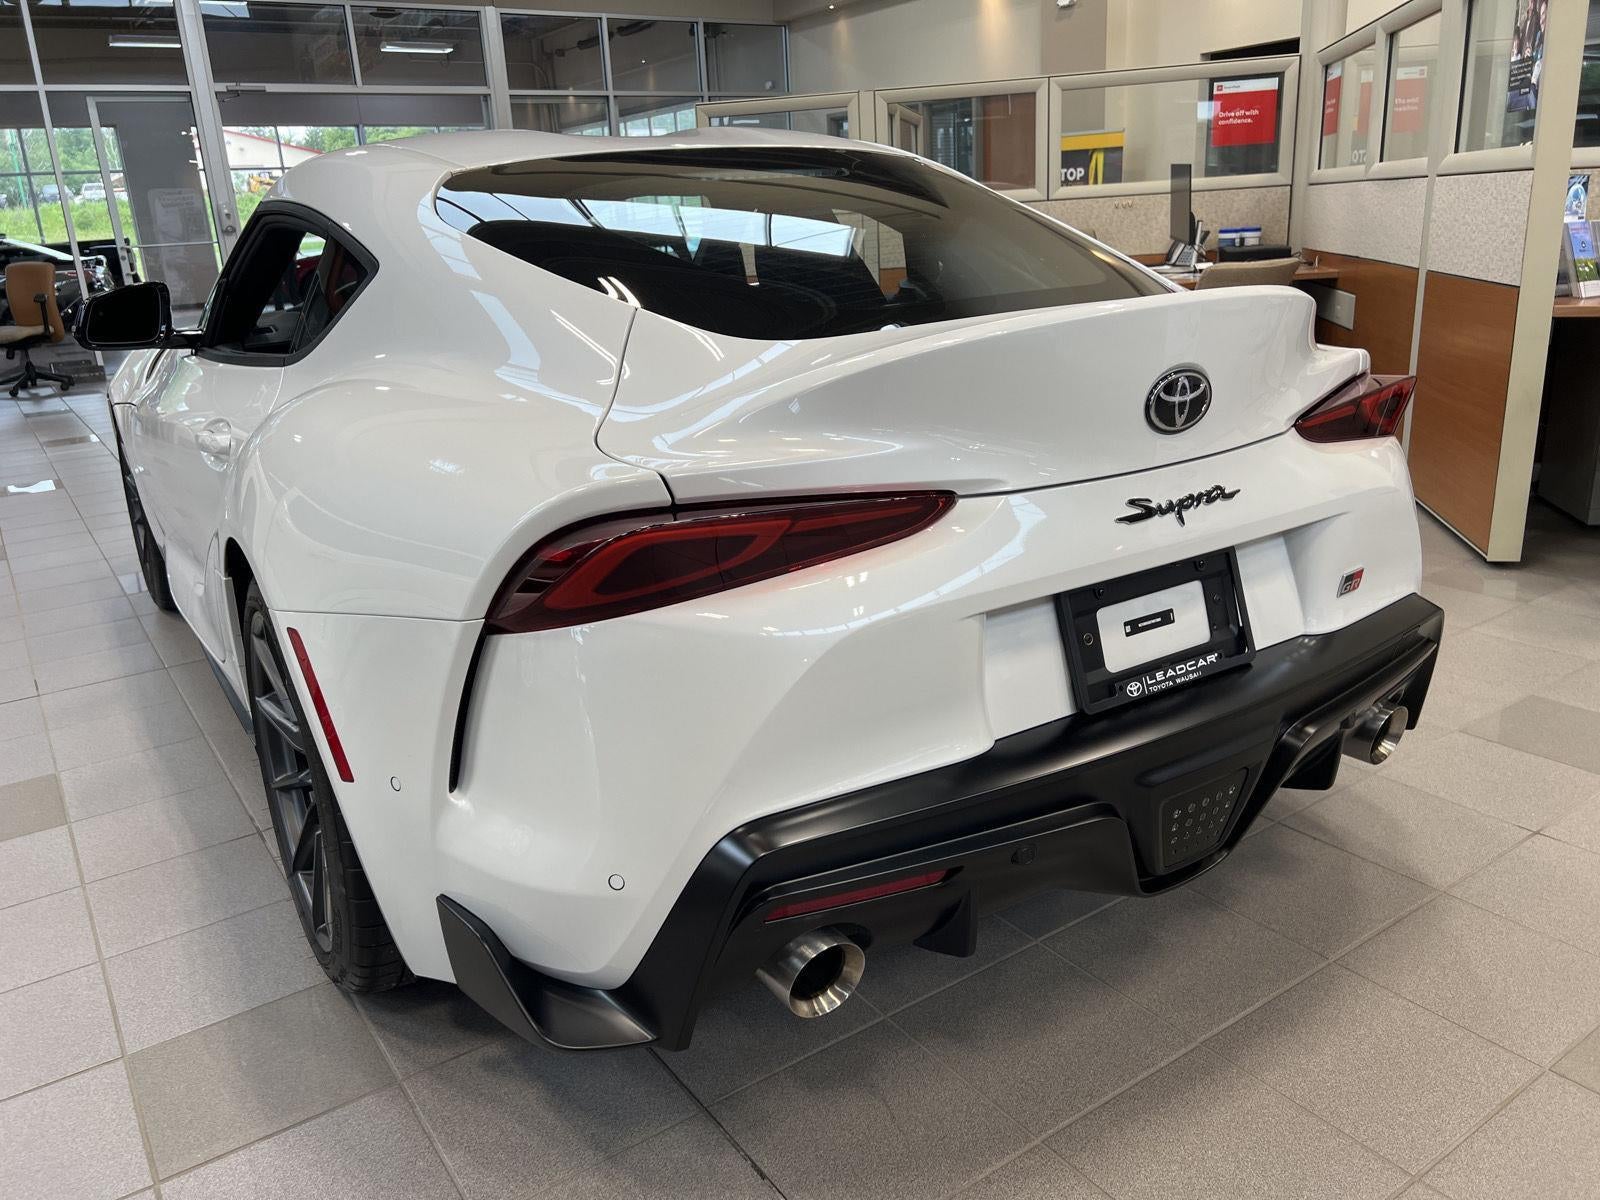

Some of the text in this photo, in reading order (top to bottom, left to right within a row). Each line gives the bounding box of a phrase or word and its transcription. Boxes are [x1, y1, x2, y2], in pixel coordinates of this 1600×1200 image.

[1218, 118, 1253, 126] confidence.
[1114, 484, 1241, 528] Supra
[1146, 653, 1218, 684] LEADCAR
[1148, 681, 1174, 693] TOYOTA
